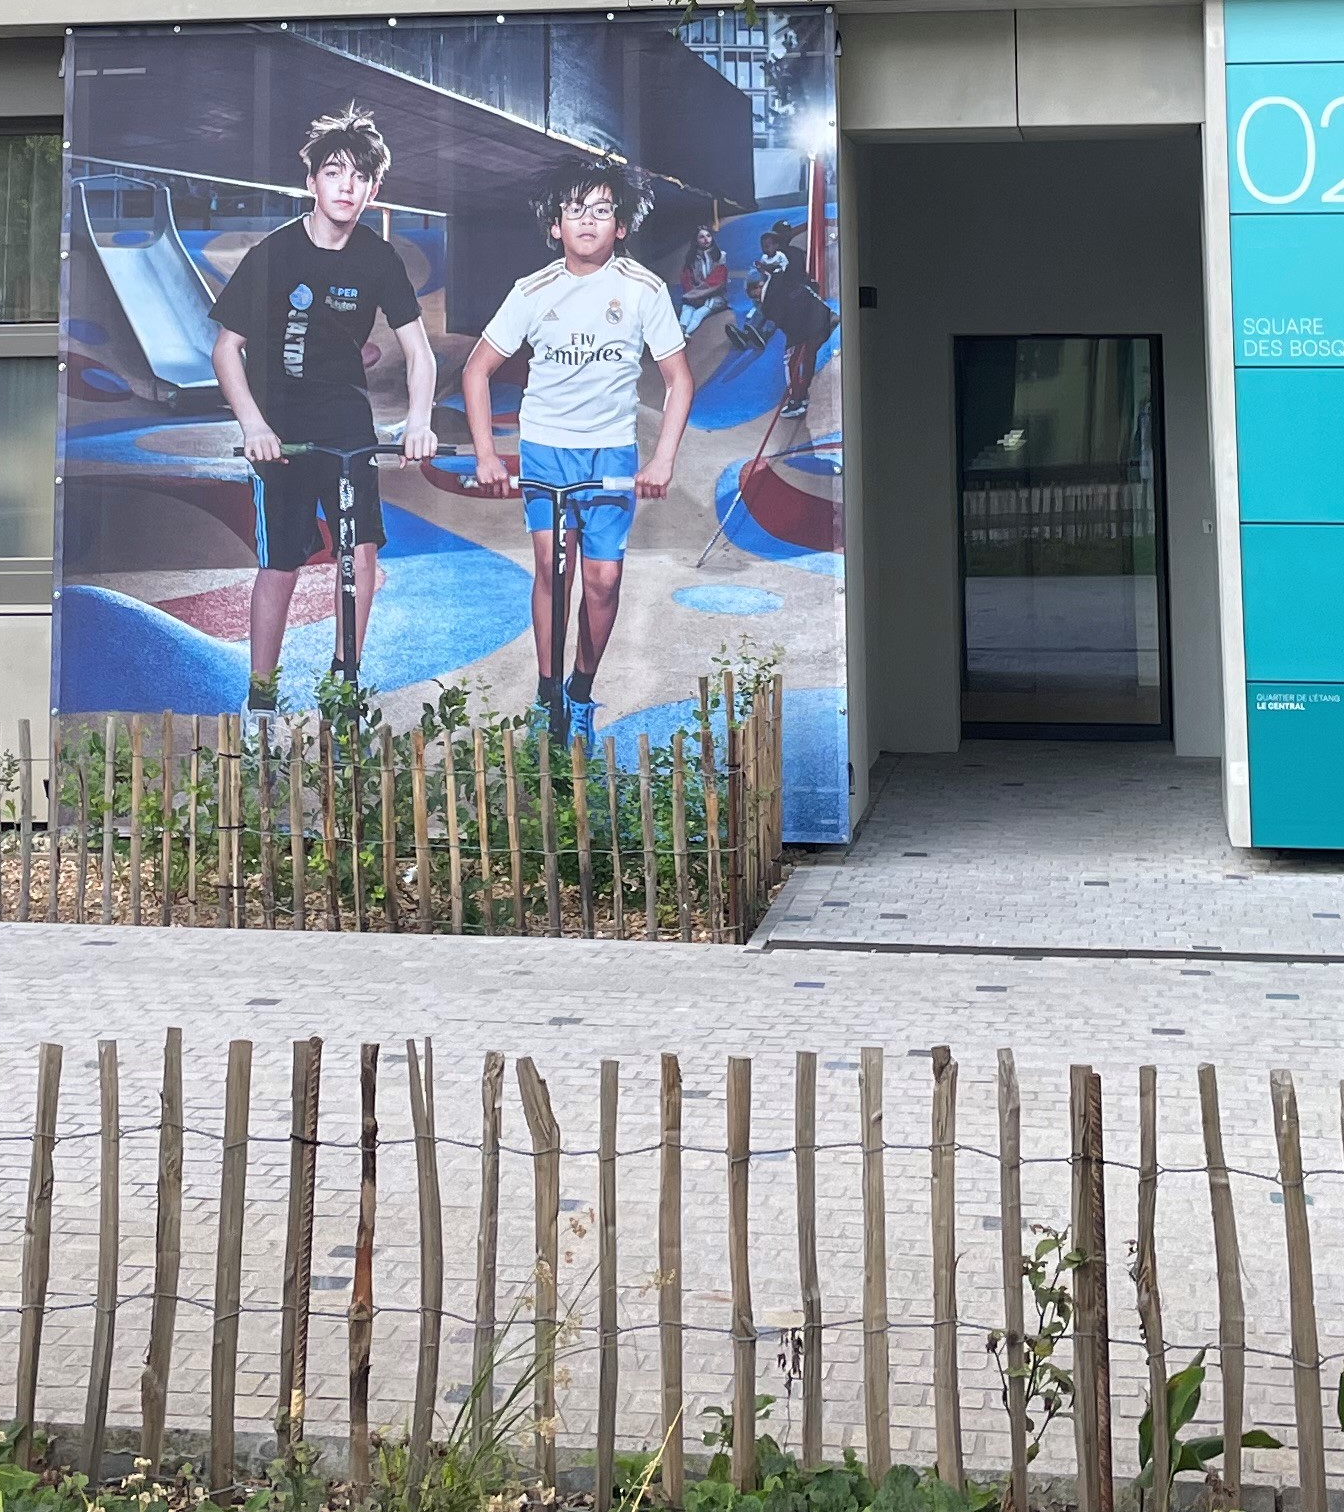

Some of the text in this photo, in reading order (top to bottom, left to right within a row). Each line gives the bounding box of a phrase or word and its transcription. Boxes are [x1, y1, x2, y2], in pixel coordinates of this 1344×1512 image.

[1243, 317, 1325, 336] SQUARE
[570, 332, 596, 348] Fly
[1243, 340, 1284, 357] DES
[1256, 693, 1295, 703] QUARTIER
[1296, 694, 1307, 702] DE
[1256, 702, 1306, 711] LE CENTRAL
